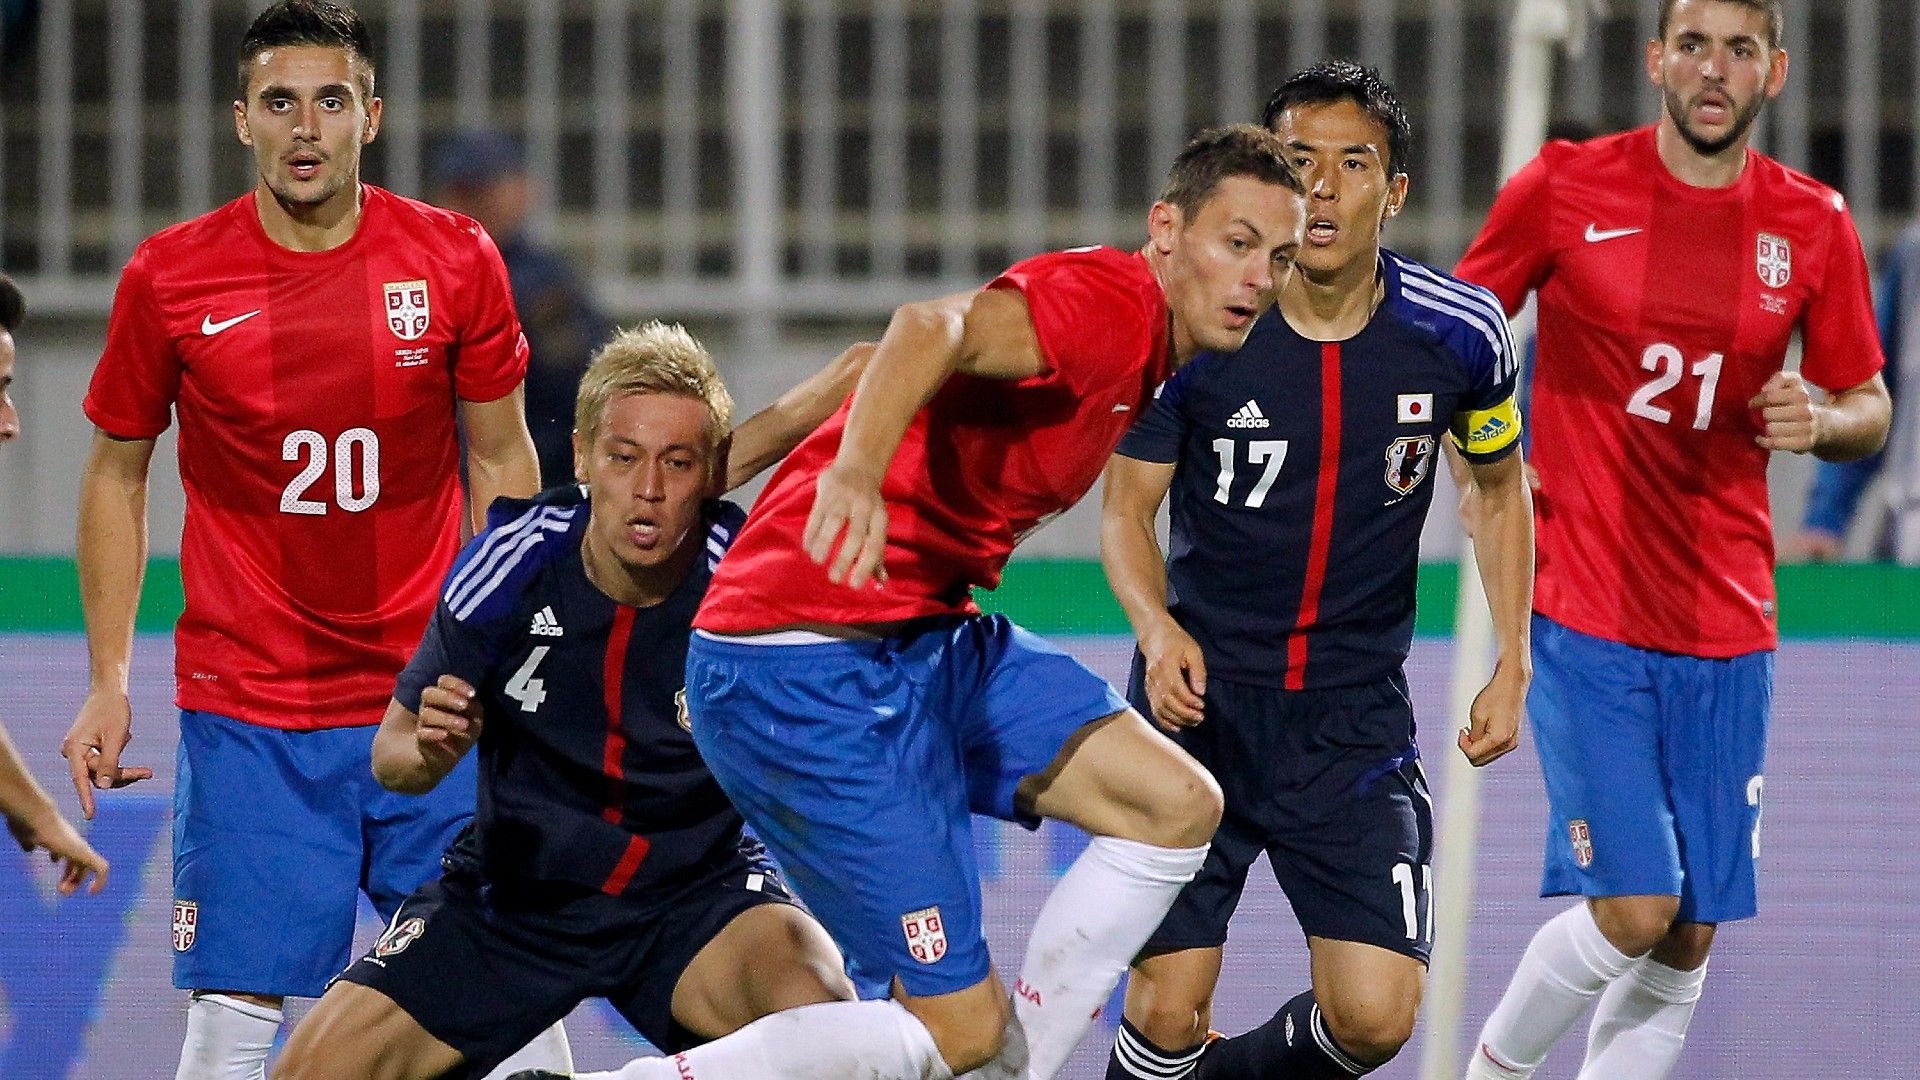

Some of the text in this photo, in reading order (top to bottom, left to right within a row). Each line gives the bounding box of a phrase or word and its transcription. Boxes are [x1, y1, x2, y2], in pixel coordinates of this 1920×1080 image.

[1226, 417, 1270, 428] adidas
[1626, 343, 1724, 431] 21
[280, 427, 380, 515] 20
[1212, 437, 1288, 508] 17
[504, 645, 550, 713] 4
